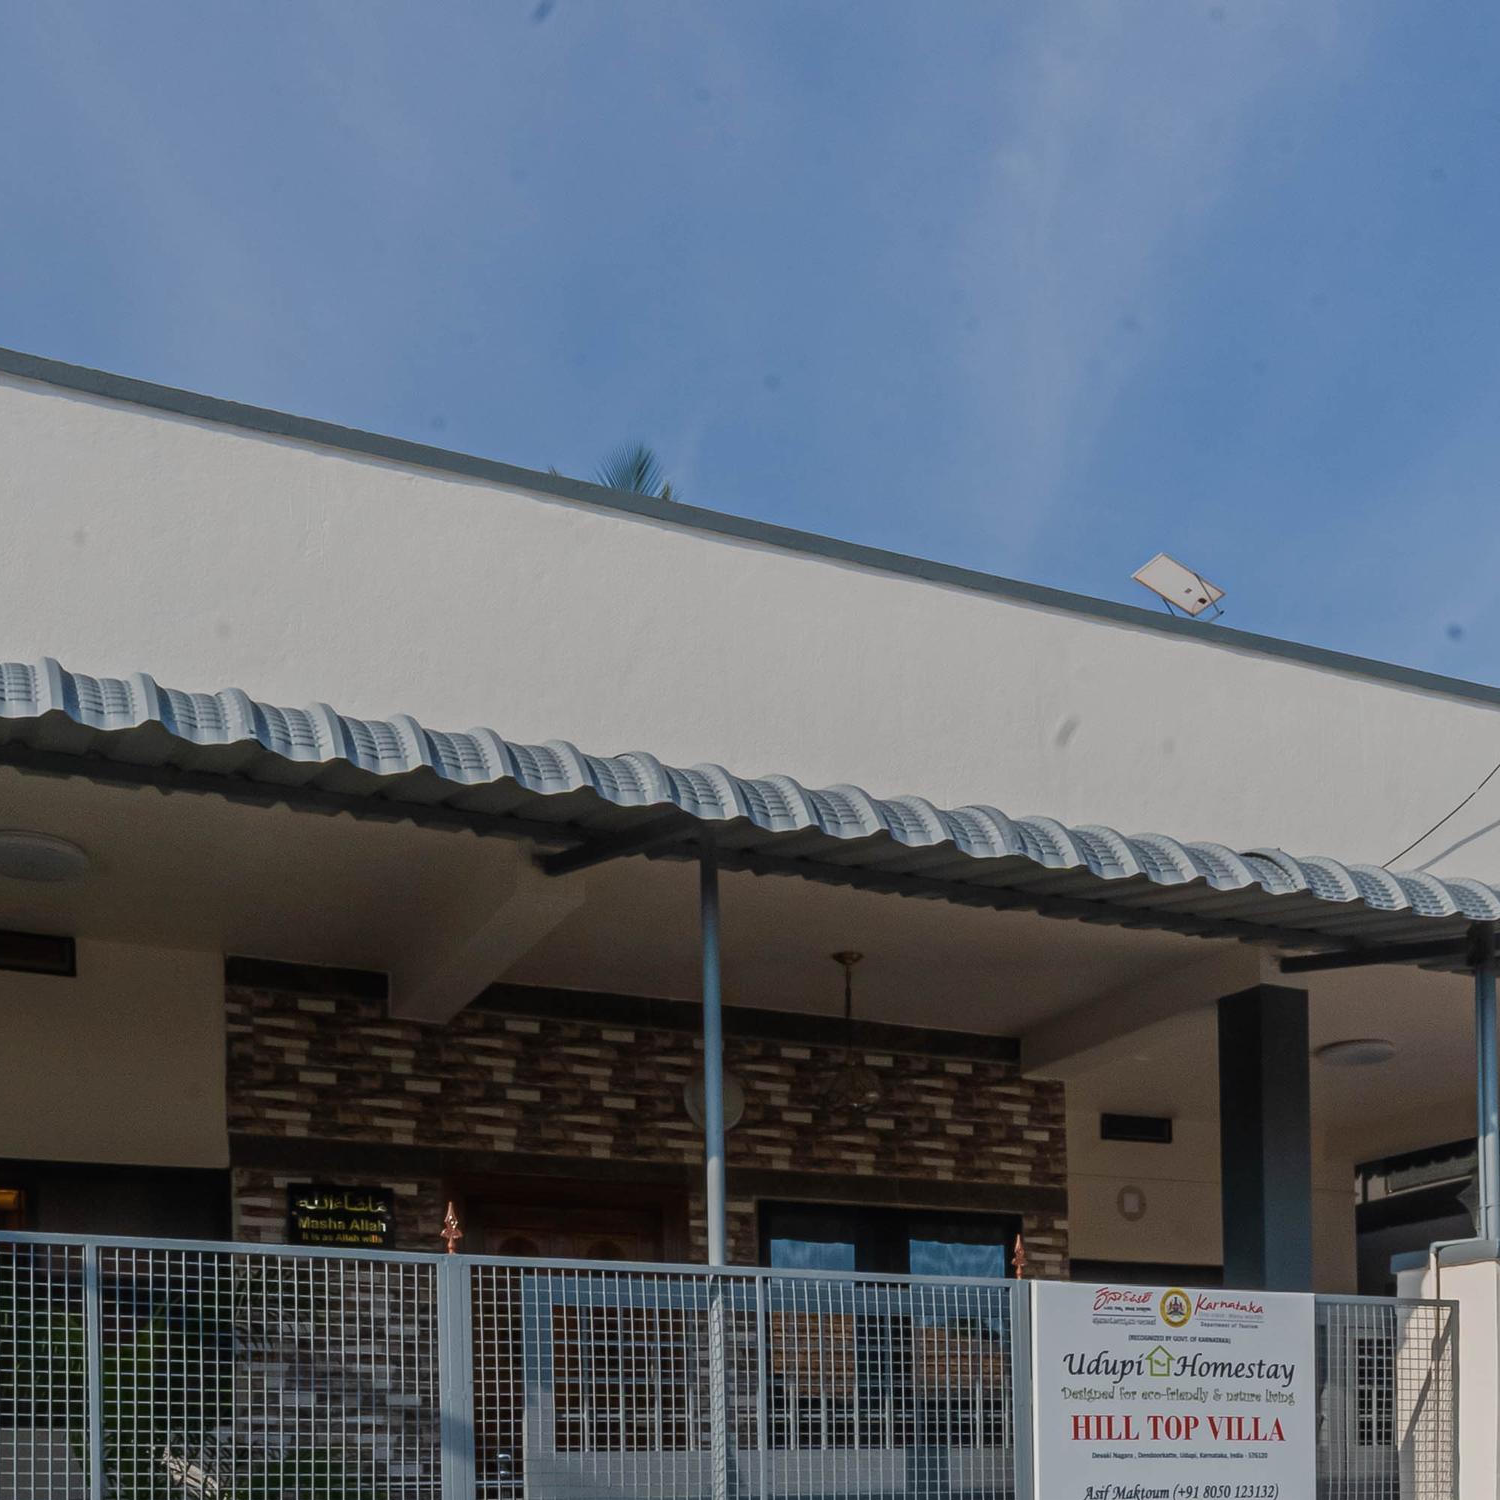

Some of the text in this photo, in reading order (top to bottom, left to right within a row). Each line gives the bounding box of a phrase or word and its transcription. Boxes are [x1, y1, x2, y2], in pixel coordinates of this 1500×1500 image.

[299, 1216, 387, 1232] Masha Allah
[336, 1234, 360, 1243] Allah
[1194, 1293, 1264, 1315] Karnataka
[1063, 1350, 1295, 1388] Udupi Homestay
[1061, 1386, 1296, 1406] Designed for eco-friendly & nature living
[1071, 1415, 1286, 1442] HILL TOP VILLA
[1203, 1485, 1232, 1499] 8050
